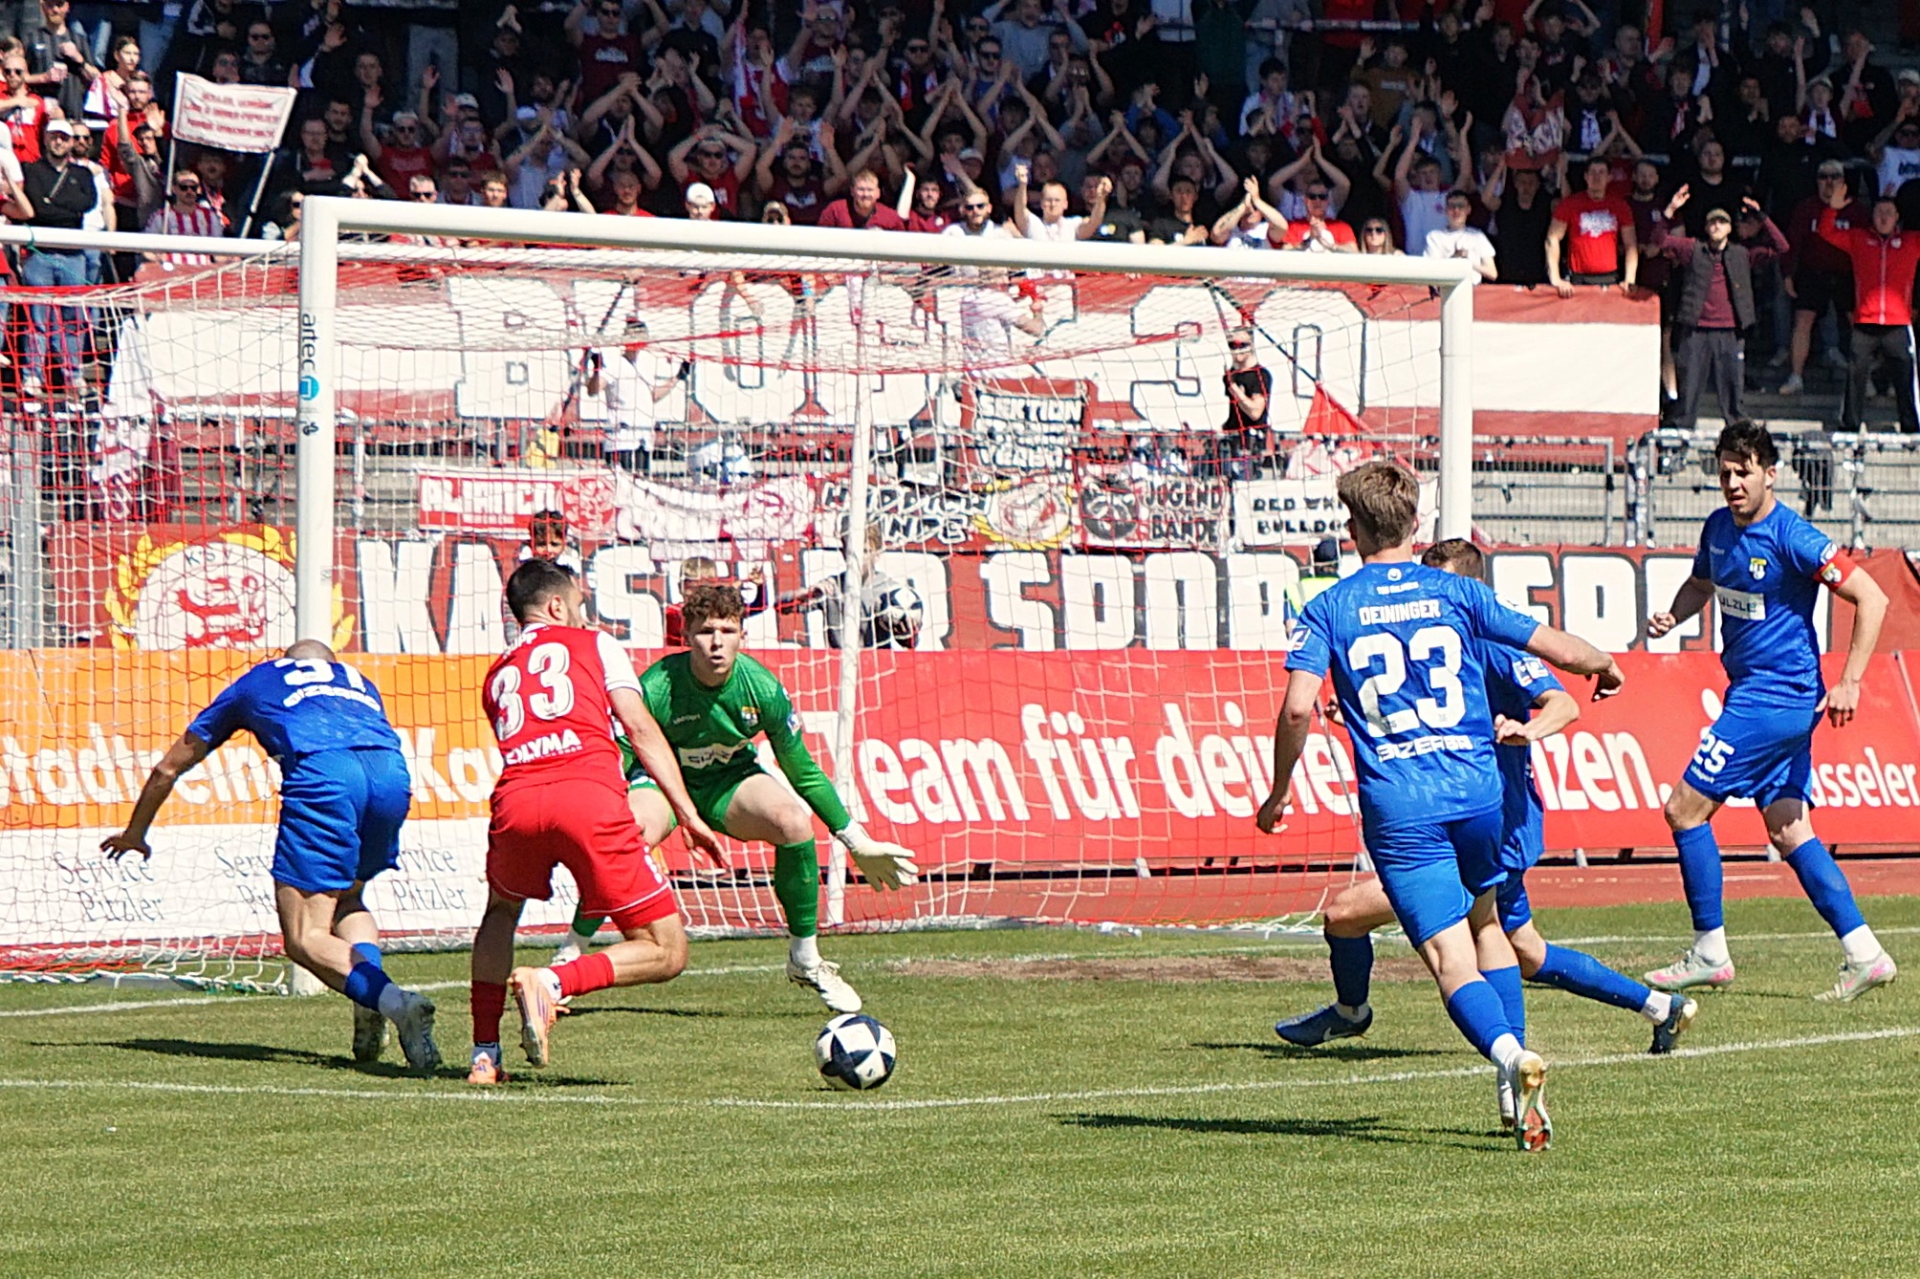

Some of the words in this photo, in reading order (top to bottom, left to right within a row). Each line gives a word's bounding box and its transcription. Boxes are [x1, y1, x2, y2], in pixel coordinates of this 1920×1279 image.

[301, 313, 317, 371] artec
[1359, 599, 1441, 626] DEININGER
[491, 642, 575, 742] 33
[1348, 625, 1466, 738] 23
[801, 710, 1030, 824] Team
[1021, 703, 1141, 820] für
[1693, 733, 1735, 775] 25
[53, 851, 155, 885] Service
[76, 887, 165, 922] Pitzler
